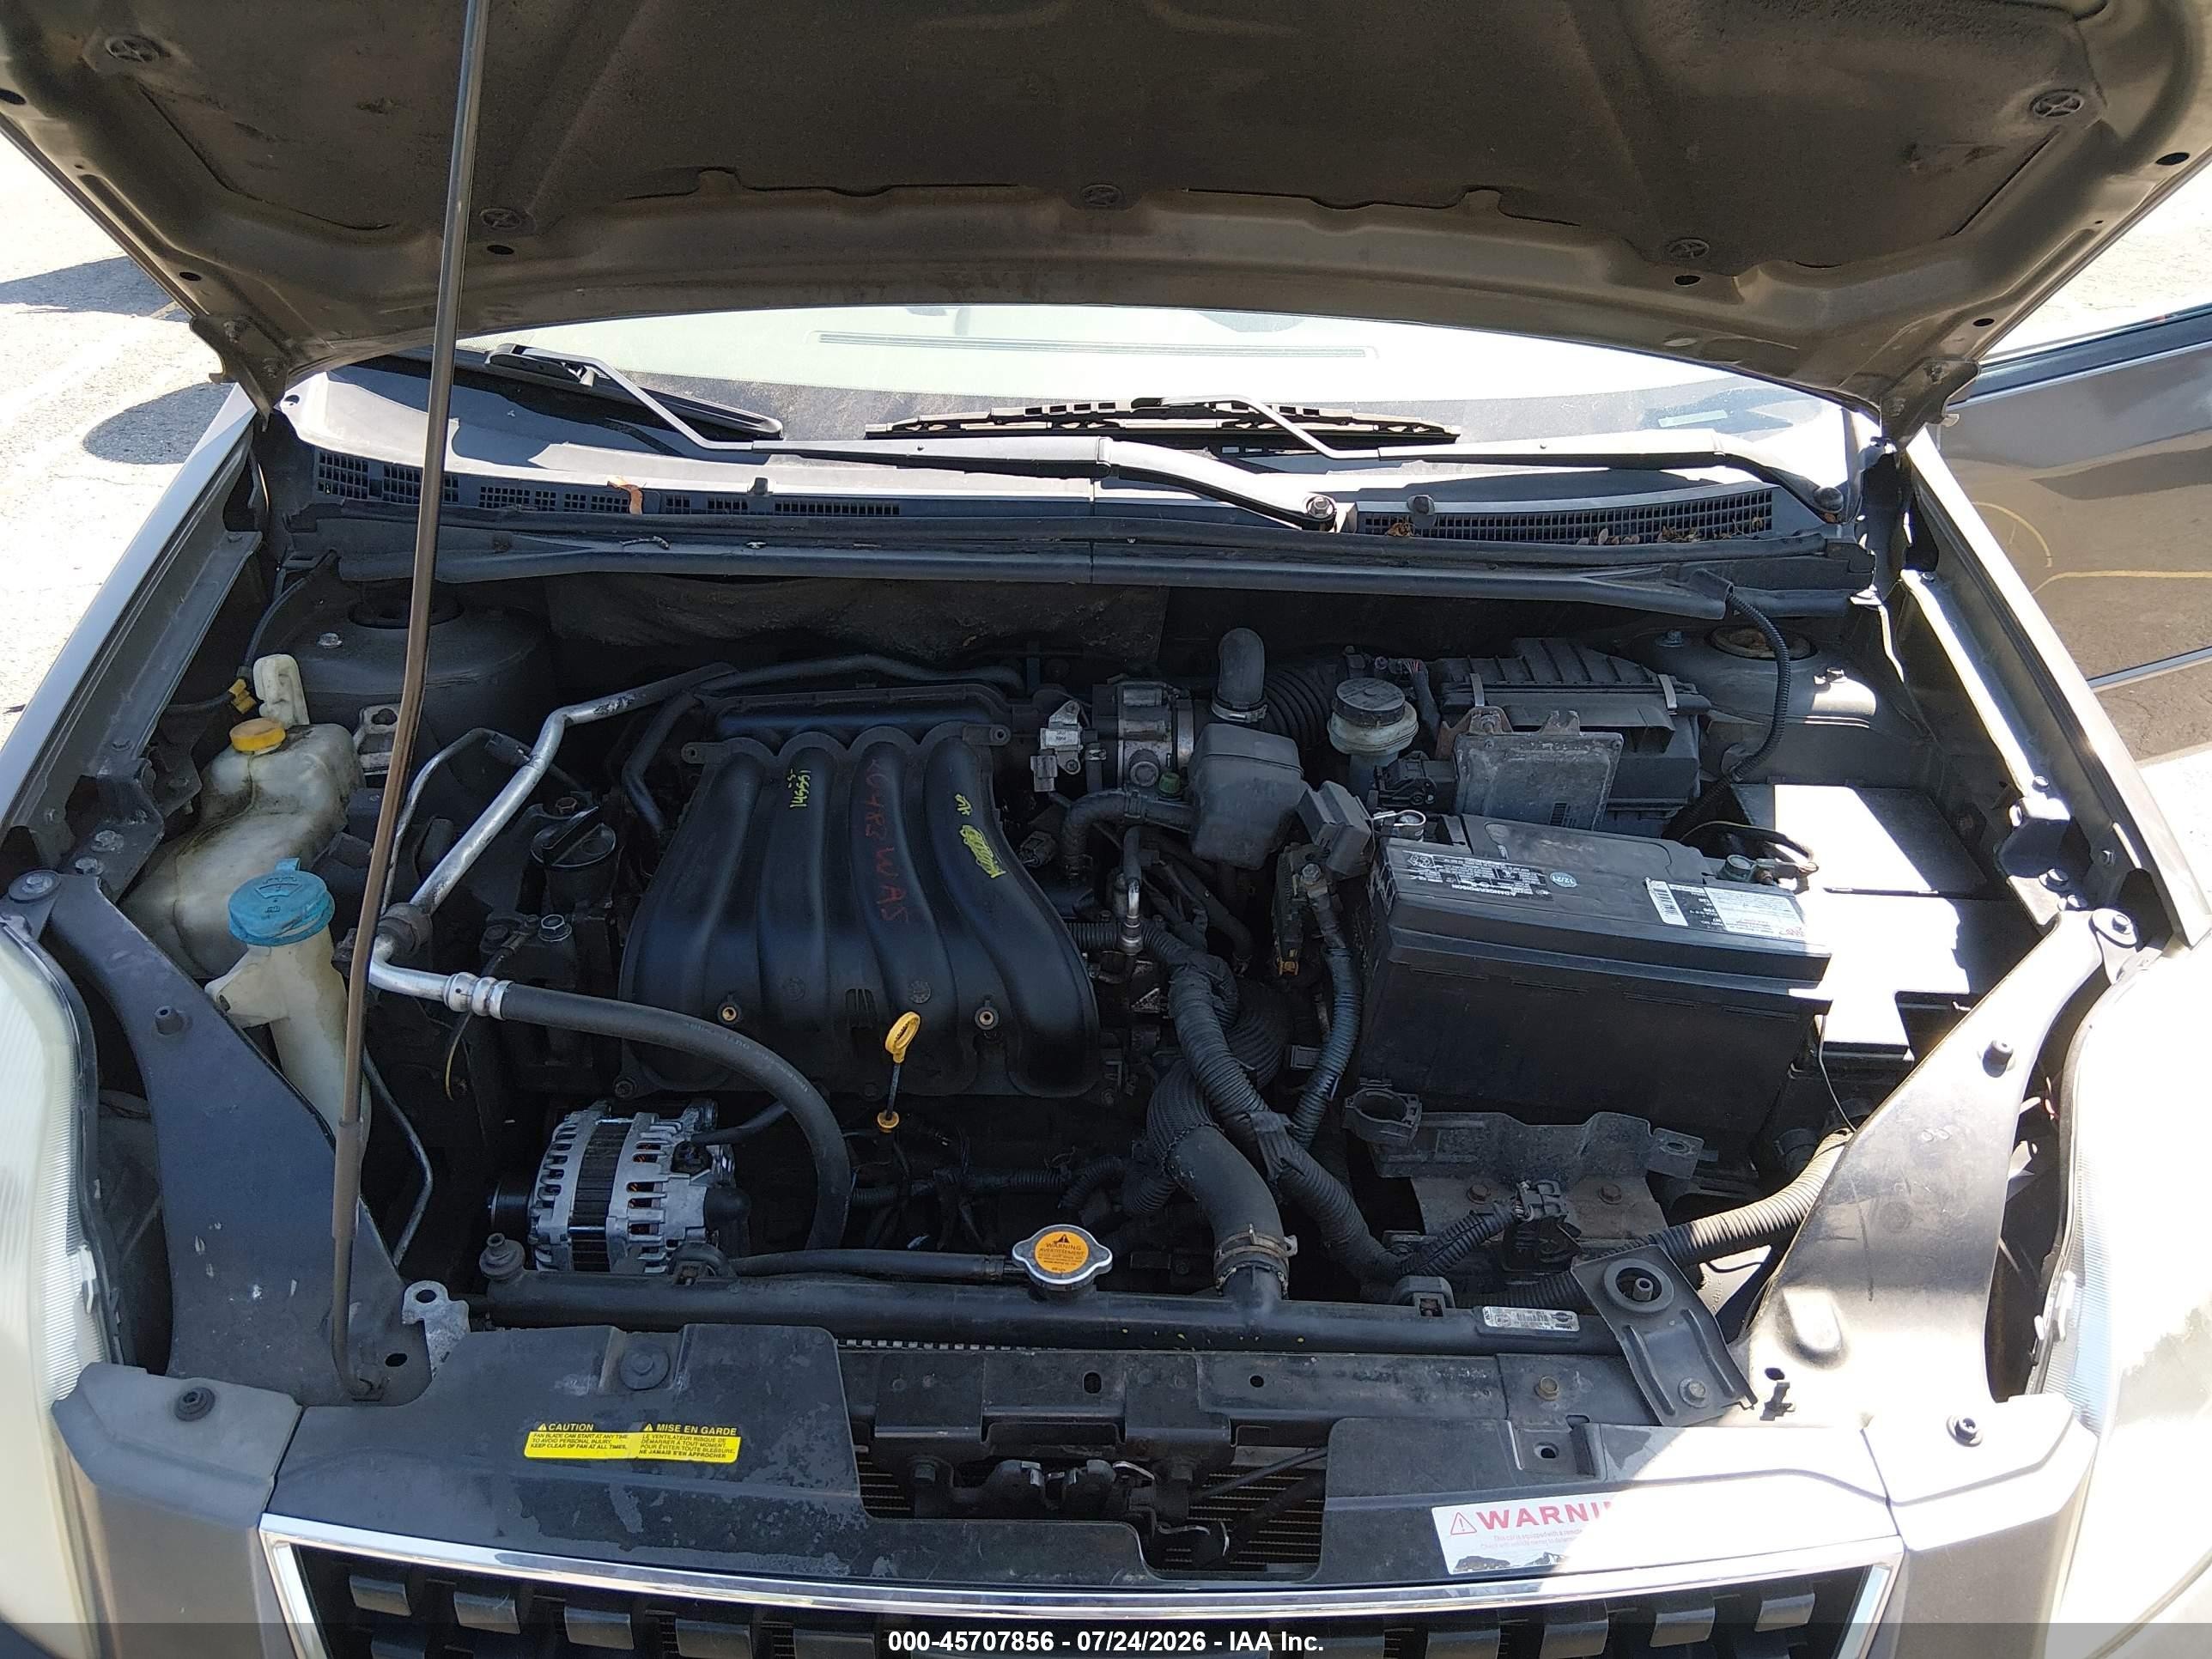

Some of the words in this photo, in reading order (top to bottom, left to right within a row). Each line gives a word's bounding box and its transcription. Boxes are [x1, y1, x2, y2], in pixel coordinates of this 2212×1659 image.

[1046, 1243, 1081, 1251] WARNING
[548, 1423, 594, 1431] CAUTION
[656, 1423, 682, 1432] MISE
[684, 1425, 698, 1434] EN
[701, 1426, 738, 1436] GARDE
